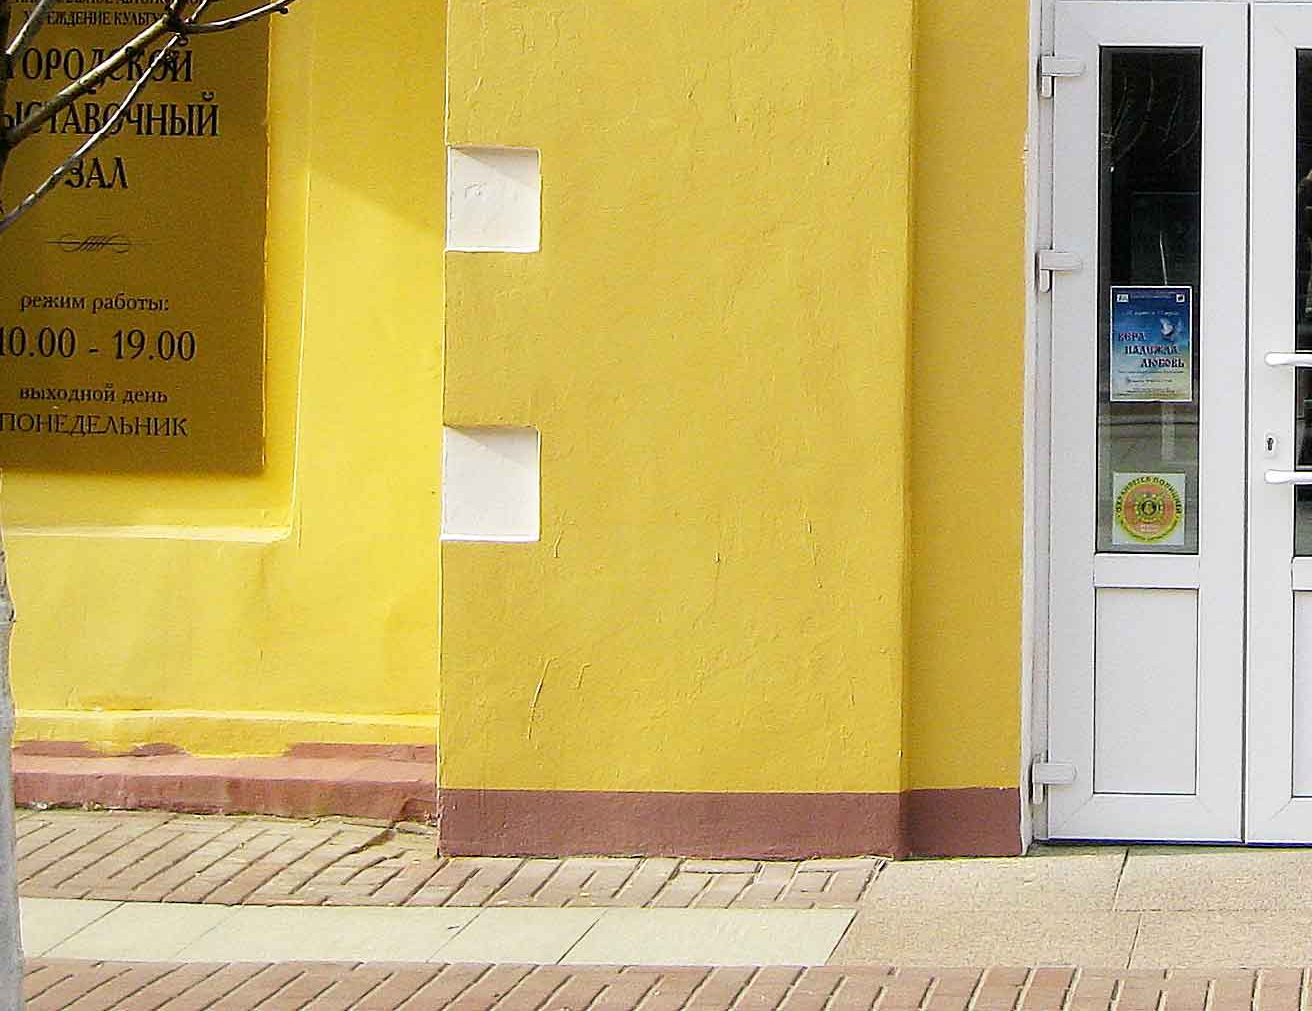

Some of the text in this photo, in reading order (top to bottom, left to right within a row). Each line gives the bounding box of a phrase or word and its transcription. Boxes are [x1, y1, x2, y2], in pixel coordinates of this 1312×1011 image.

[0, 90, 219, 137] ЫСТАВОЧНЫЙ
[64, 157, 129, 189] ЗАЛ
[20, 292, 169, 314] режим работы:
[0, 327, 76, 358] 10.00
[112, 329, 197, 362] 19.00
[19, 383, 168, 406] выходной день
[0, 412, 188, 438] ПОНЕДЕЛЬНИК
